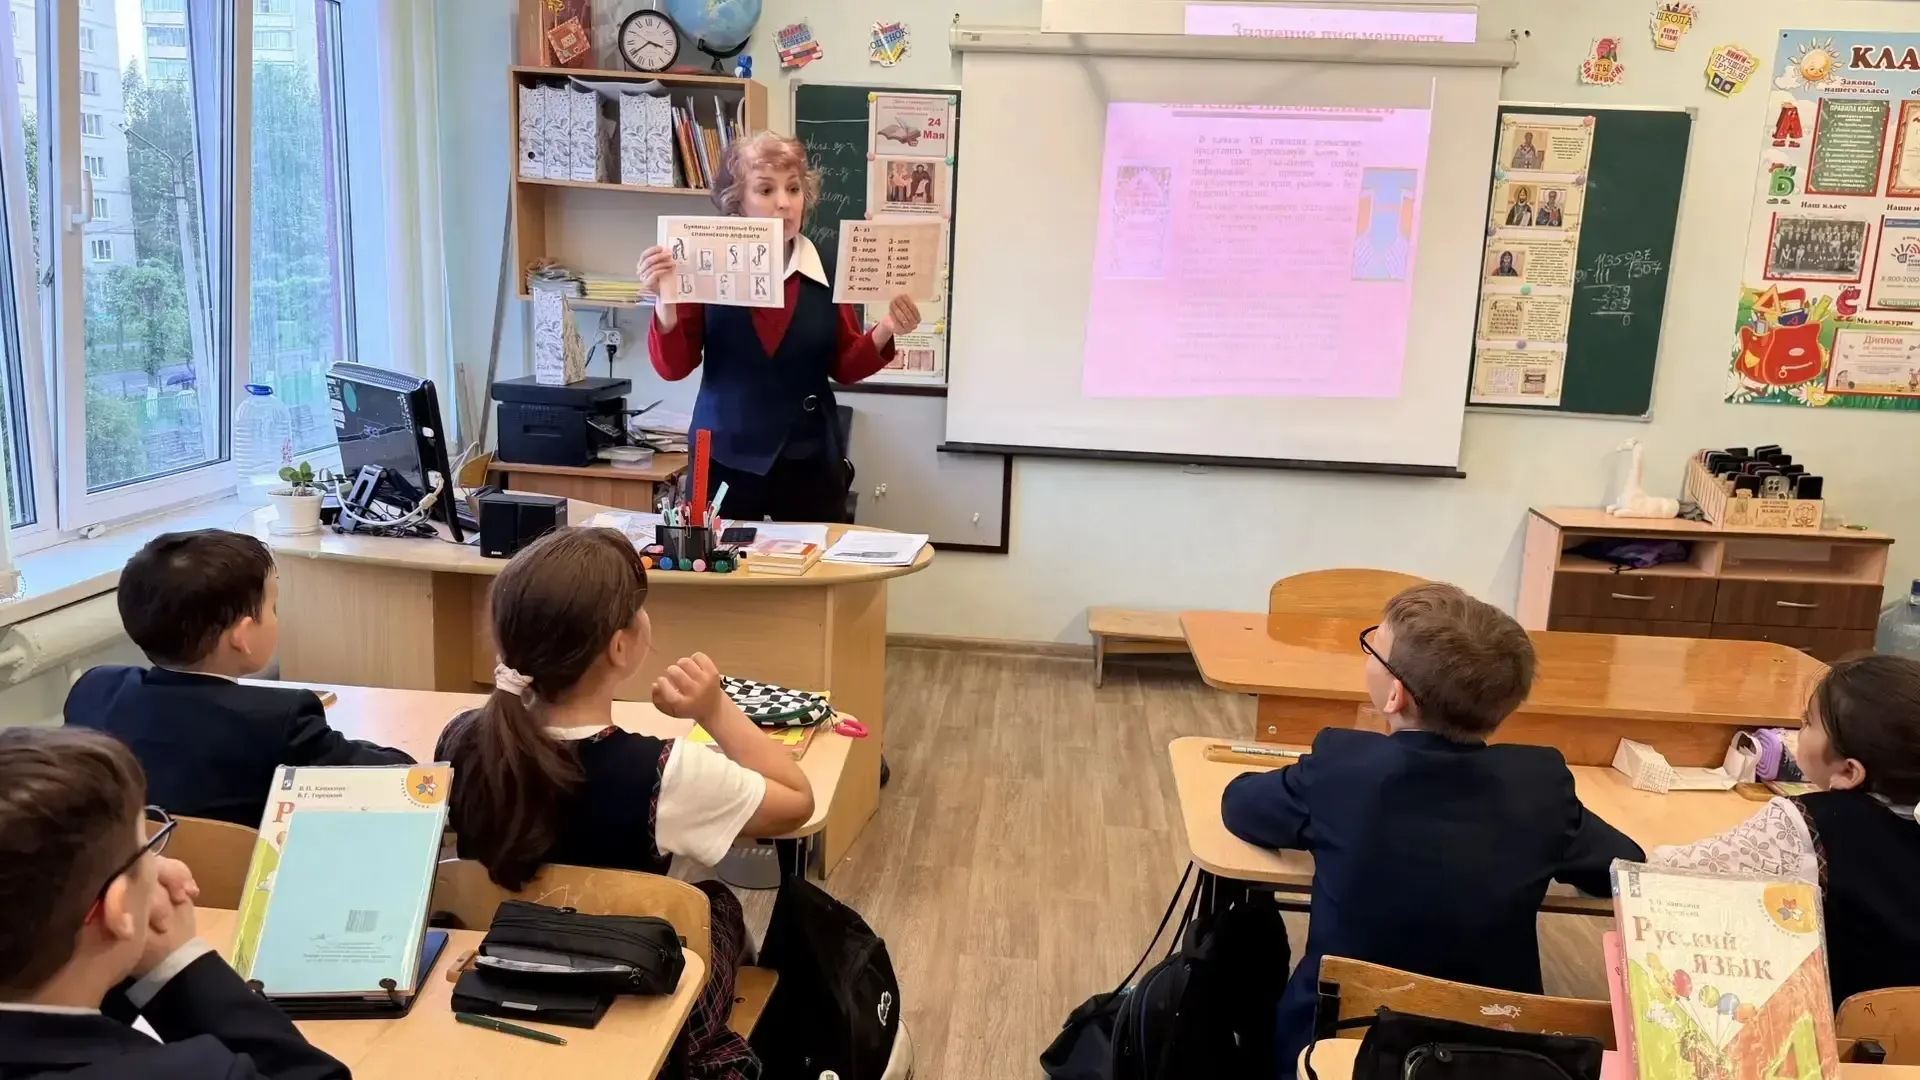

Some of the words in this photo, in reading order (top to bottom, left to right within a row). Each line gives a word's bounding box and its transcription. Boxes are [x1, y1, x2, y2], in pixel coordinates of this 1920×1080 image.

[1656, 11, 1692, 26] ШКОЛА
[1716, 53, 1750, 74] ЛУЧШИЕ
[1712, 60, 1746, 80] ДРУЗЬЯ!
[1840, 78, 1876, 86] Законы
[1829, 104, 1856, 112] ПРАВИЛА
[1857, 105, 1880, 113] КЛАССА
[927, 118, 941, 127] 24
[923, 130, 945, 140] Мая
[1800, 201, 1820, 209] Наш
[1886, 203, 1912, 211] Наши
[683, 223, 711, 231] Буквицы
[748, 224, 768, 232] буквы
[1856, 316, 1871, 324] Мы
[1863, 335, 1903, 345] Диплом
[272, 801, 296, 823] Р
